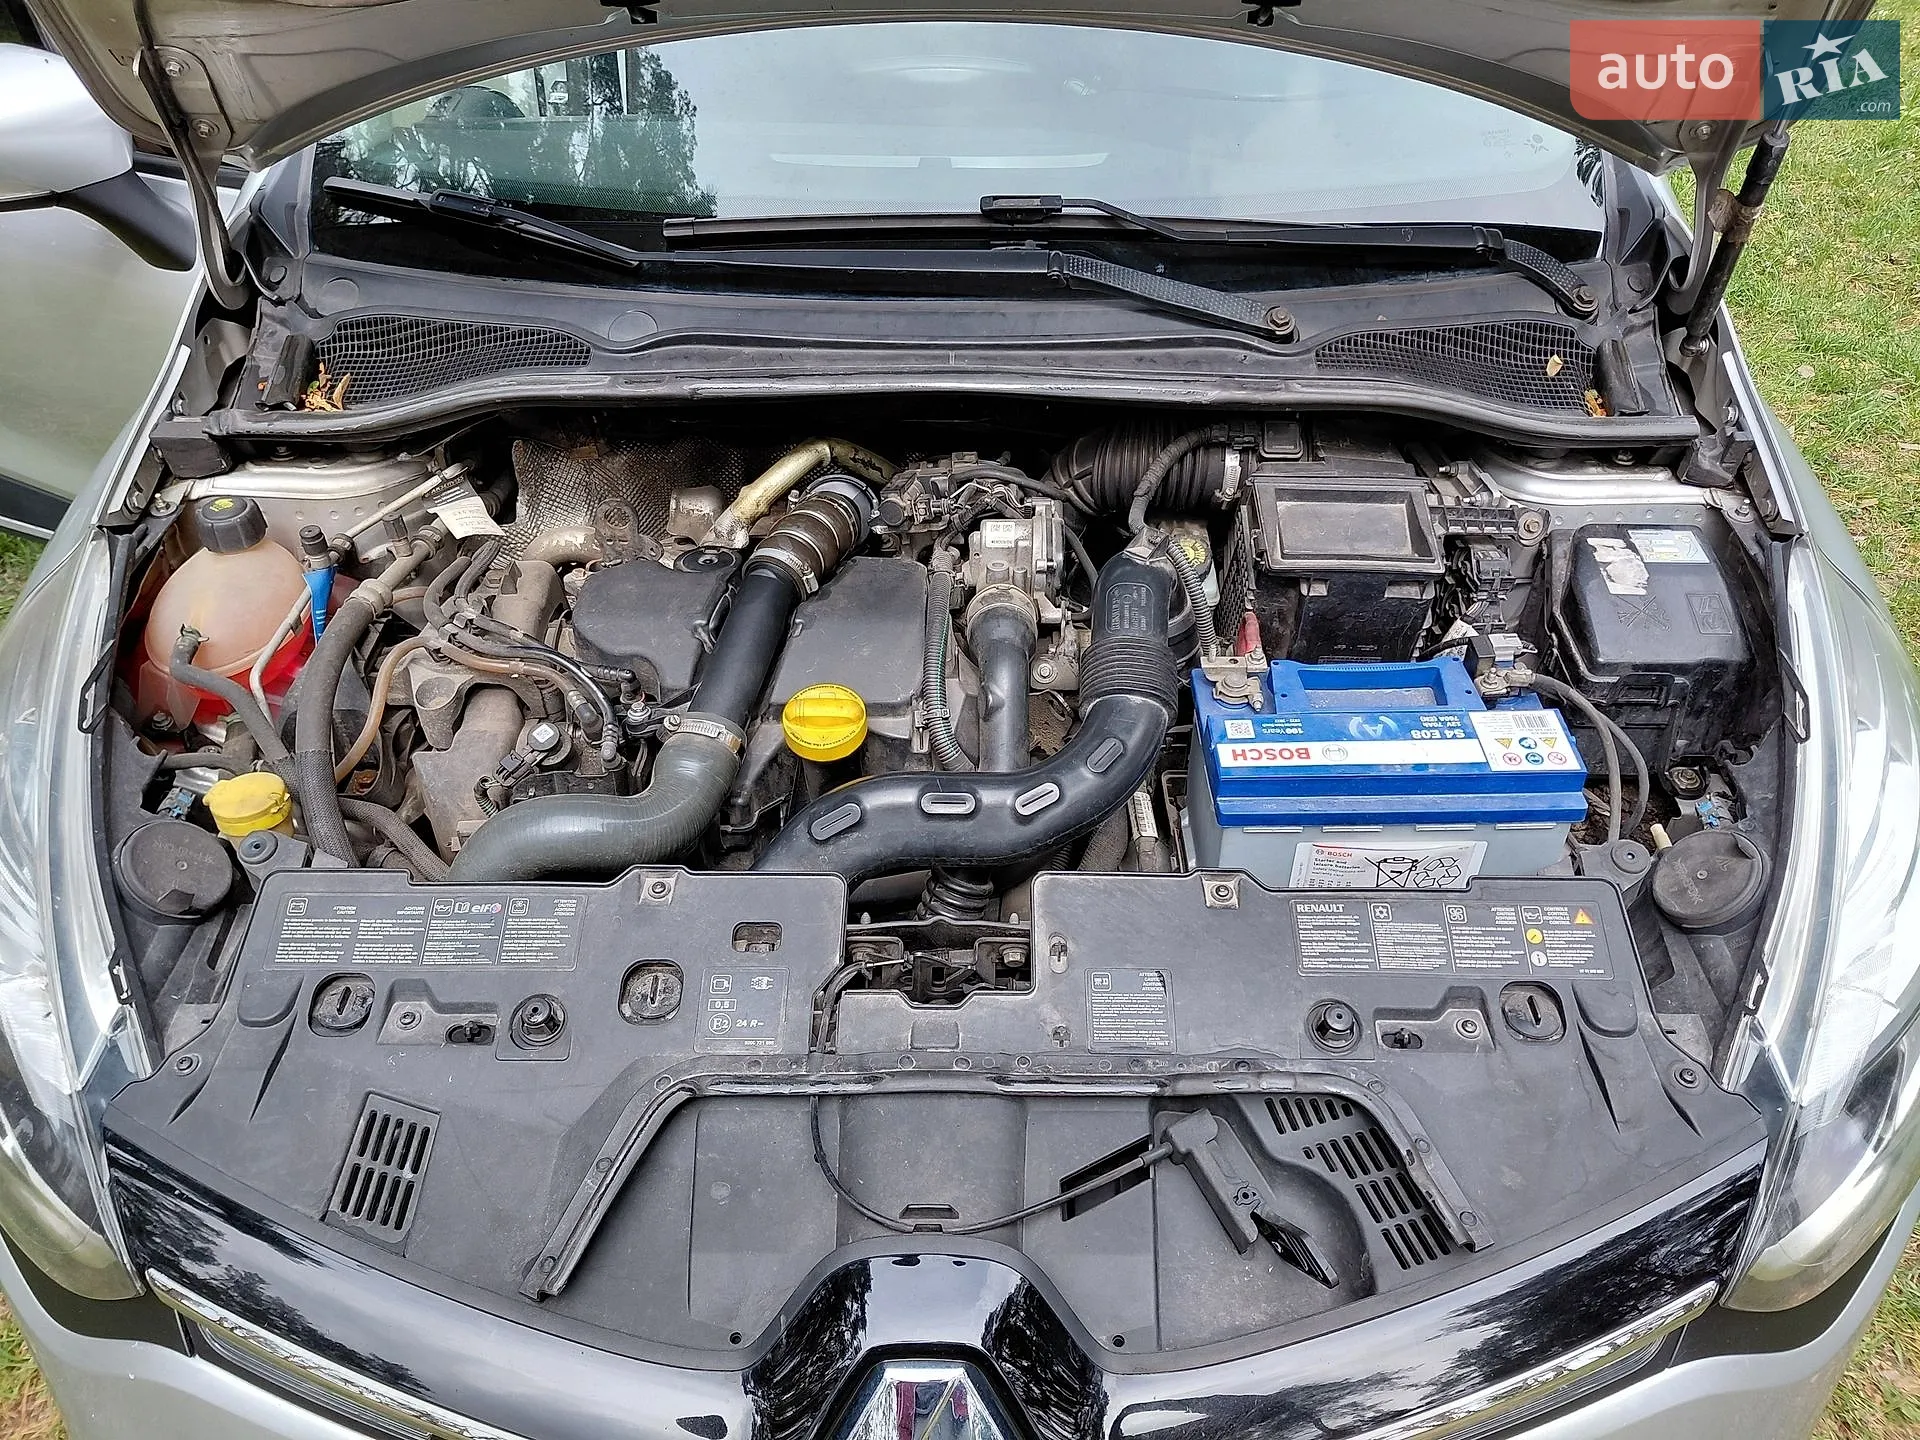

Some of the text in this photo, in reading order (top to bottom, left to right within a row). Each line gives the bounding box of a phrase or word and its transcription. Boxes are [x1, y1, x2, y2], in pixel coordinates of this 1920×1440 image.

[1410, 729, 1466, 739] S4 E08
[1231, 747, 1311, 761] BOSCH
[1296, 903, 1345, 913] RENAULT
[715, 1001, 729, 1009] 0.5
[735, 1019, 748, 1028] 24
